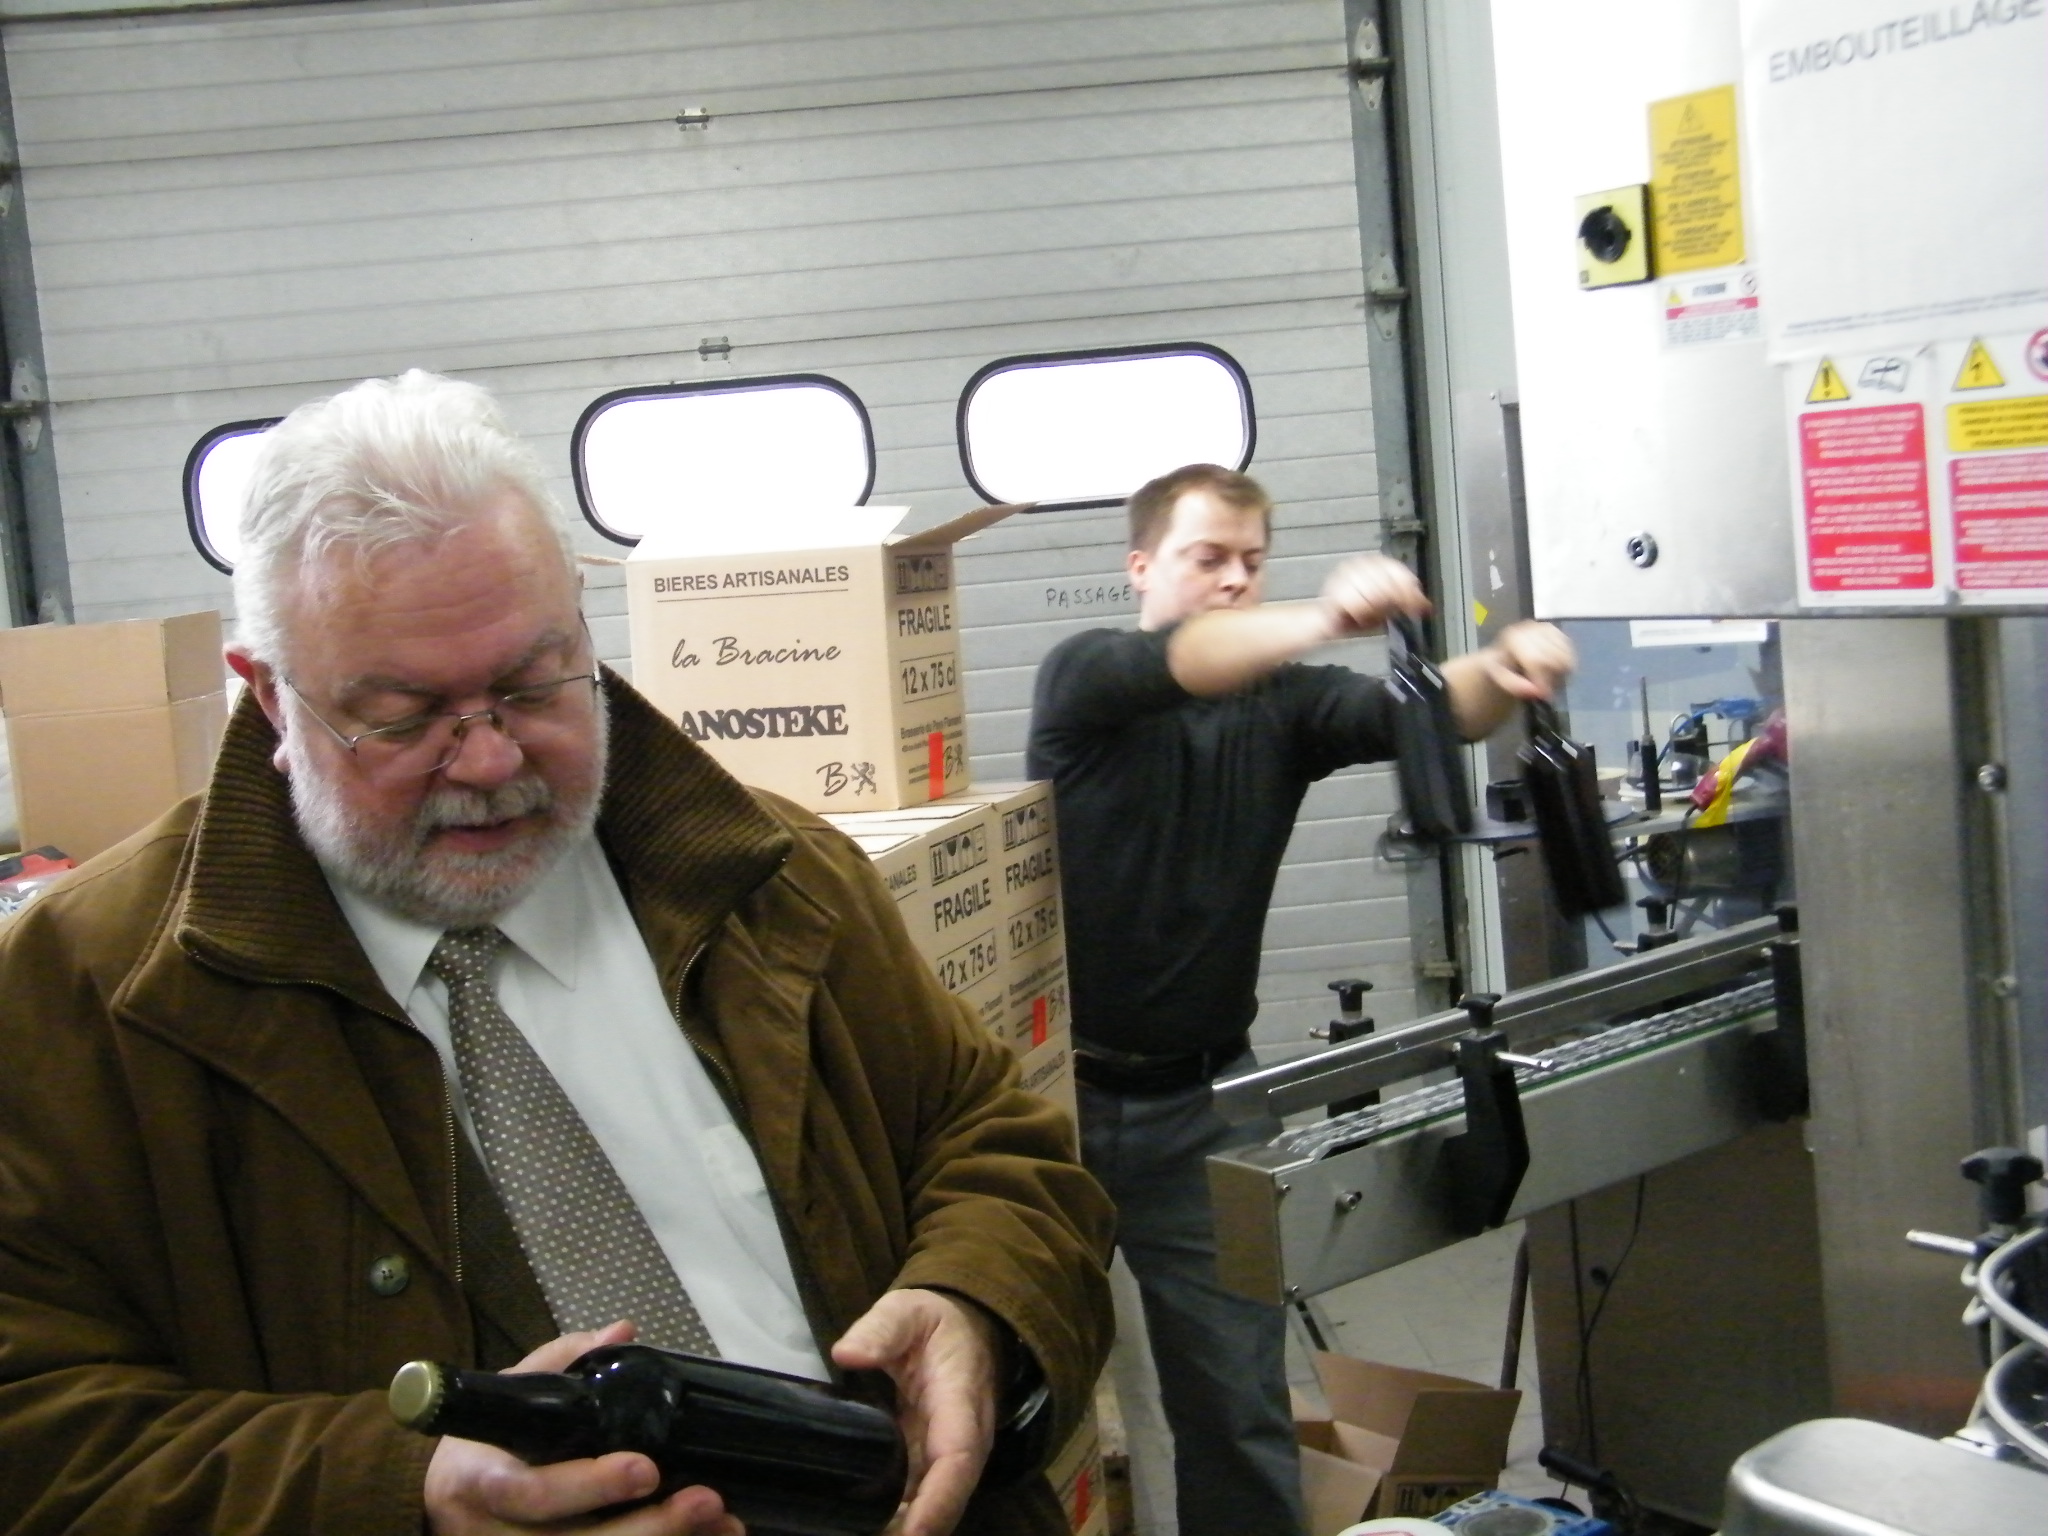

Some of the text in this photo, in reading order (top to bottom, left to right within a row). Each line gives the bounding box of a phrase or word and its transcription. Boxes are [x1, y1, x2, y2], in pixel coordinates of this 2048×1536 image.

[1769, 0, 2046, 84] EMBOUTEILLAGE
[654, 565, 850, 593] BIERES ARTISANALES
[1046, 584, 1132, 608] PASSAGE
[898, 604, 951, 637] FRAGILE
[672, 636, 841, 668] la Bracine
[902, 659, 956, 695] 12 x 75 cl
[681, 704, 849, 741] ANOSTEKE
[884, 864, 917, 891] ANALES
[1005, 848, 1054, 895] FRAGILE
[933, 878, 992, 932] FRAGILE
[1009, 920, 1023, 951] 12
[1026, 921, 1033, 943] x
[1034, 907, 1047, 937] 75
[939, 959, 956, 991] 12
[959, 959, 968, 984] x
[969, 943, 985, 977] 75
[986, 933, 997, 967] cl
